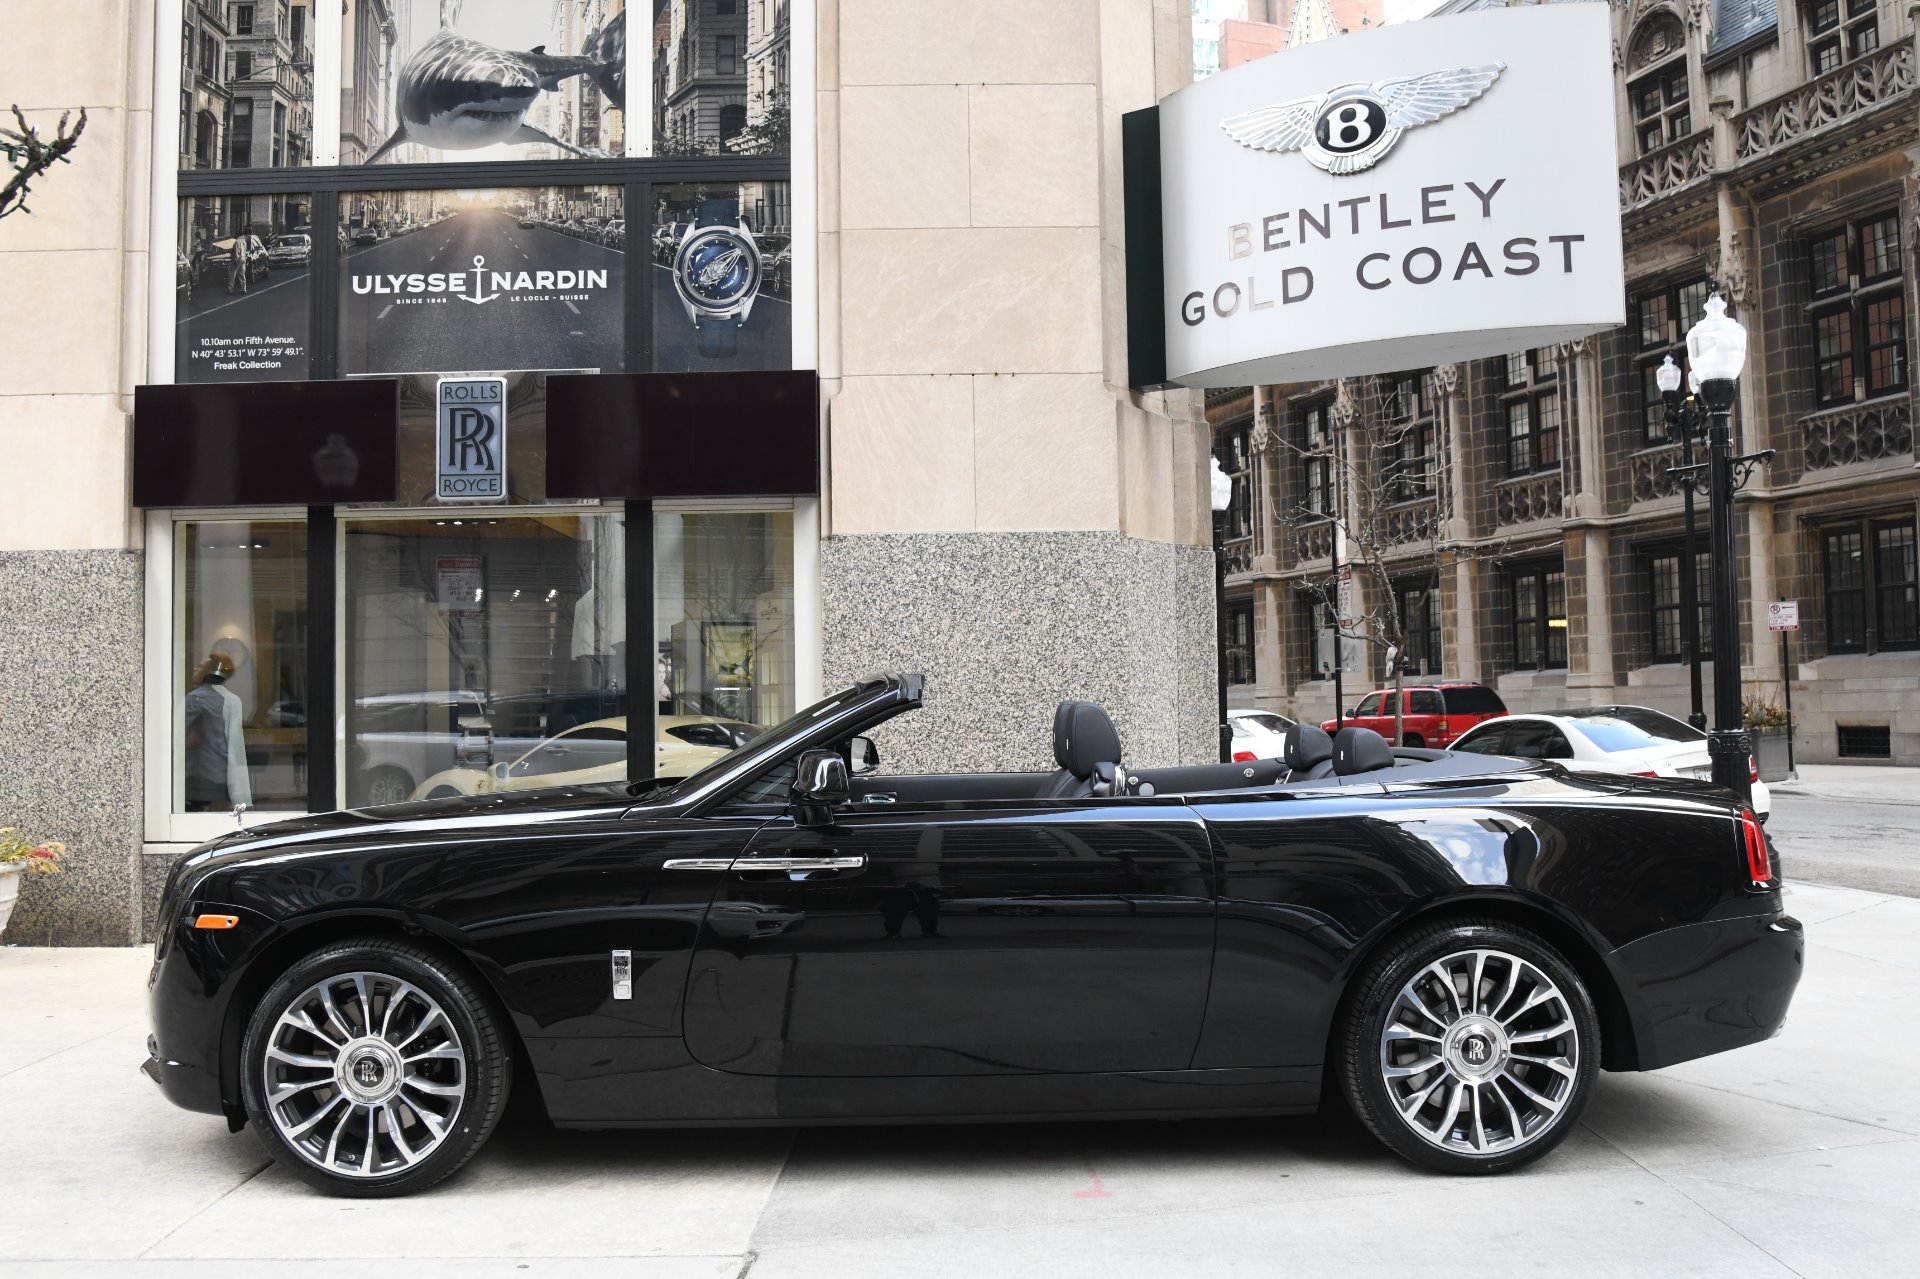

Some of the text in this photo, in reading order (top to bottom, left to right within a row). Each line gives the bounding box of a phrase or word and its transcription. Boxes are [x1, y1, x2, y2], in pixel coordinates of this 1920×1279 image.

[1326, 103, 1372, 148] B
[1228, 178, 1507, 262] BENTLEY
[352, 269, 608, 295] ULYSSE NARDIN
[1182, 234, 1585, 326] GOLD COAST
[200, 338, 231, 346] 10.10am
[245, 336, 262, 345] Fifth
[265, 336, 296, 344] Avenue.
[191, 350, 199, 359] N
[247, 348, 257, 357] W
[213, 361, 281, 370] Freak Collection
[444, 385, 498, 400] ROLLS
[448, 407, 495, 471] RR
[443, 478, 498, 492] ROYCE
